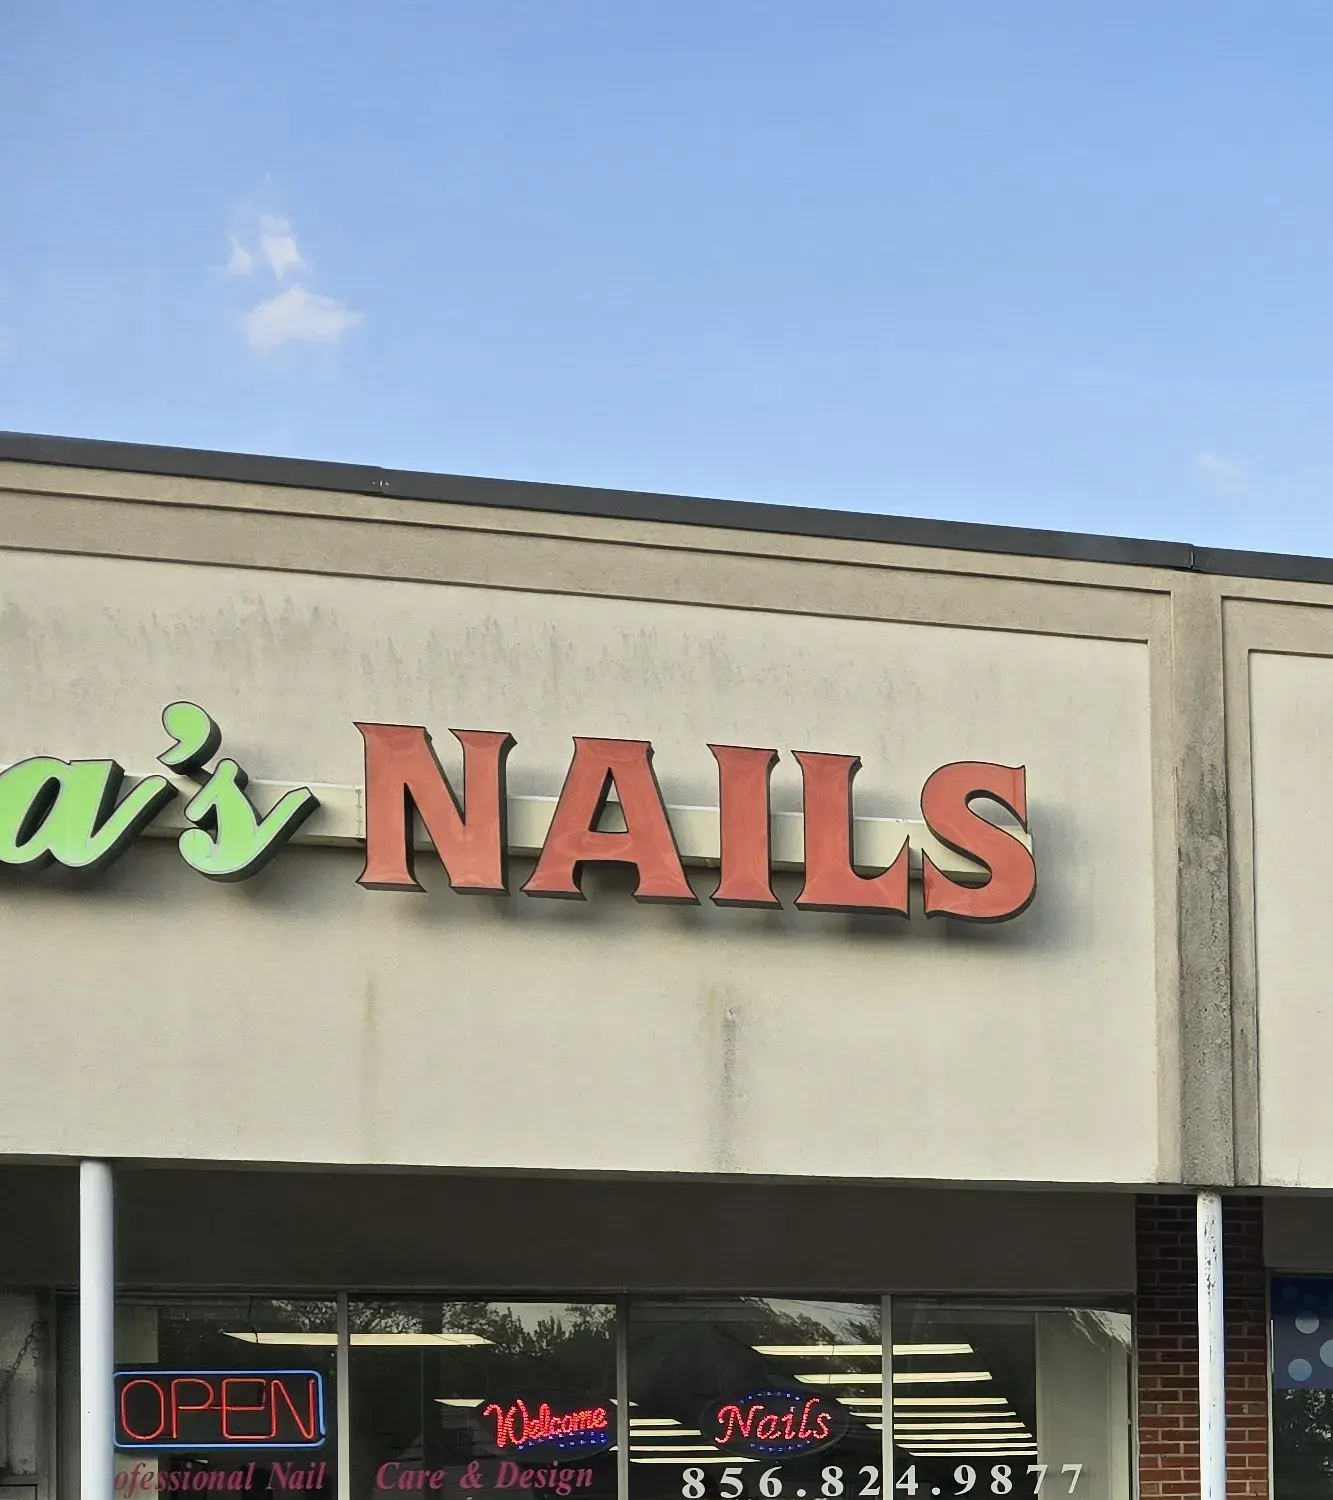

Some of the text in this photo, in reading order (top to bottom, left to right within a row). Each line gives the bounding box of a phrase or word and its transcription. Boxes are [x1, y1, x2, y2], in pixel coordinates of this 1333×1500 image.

[352, 721, 1037, 925] NAILS
[120, 1377, 317, 1441] OPEN
[483, 1399, 608, 1448] Welcome
[715, 1398, 833, 1443] Nails
[113, 1460, 593, 1498] ofessional Nail Care & Design
